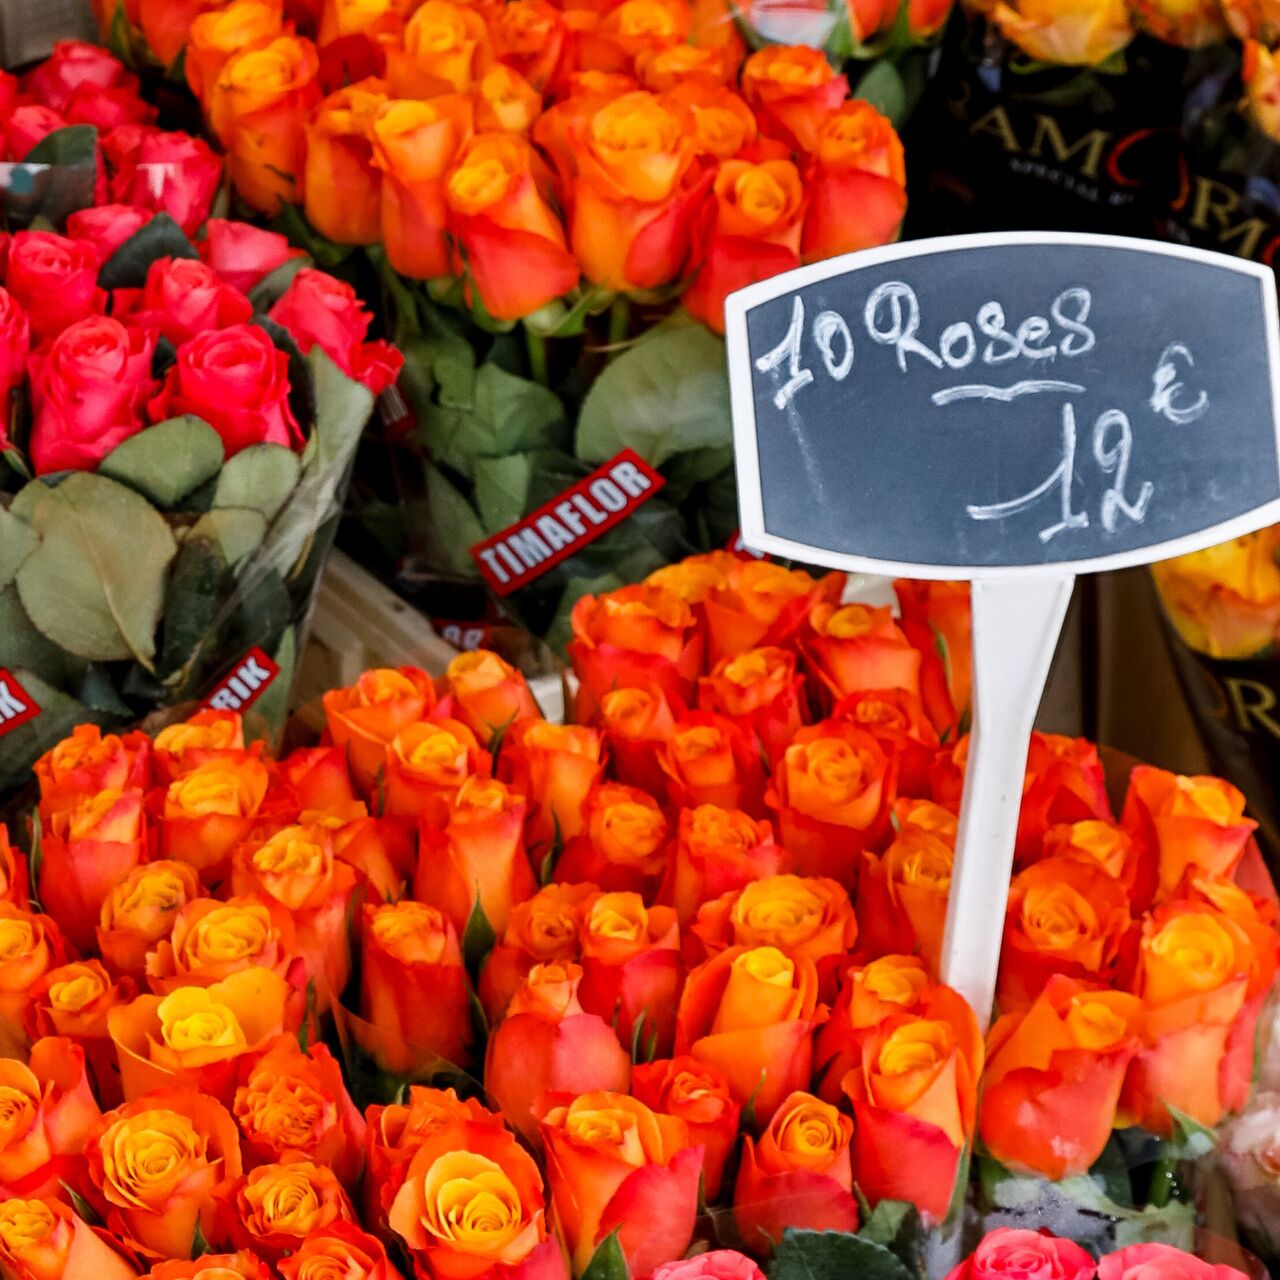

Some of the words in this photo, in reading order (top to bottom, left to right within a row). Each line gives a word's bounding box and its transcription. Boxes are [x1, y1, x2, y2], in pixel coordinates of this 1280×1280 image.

[756, 295, 854, 410] 10
[864, 281, 1097, 373] Roses
[478, 460, 653, 585] TIMAFLOR
